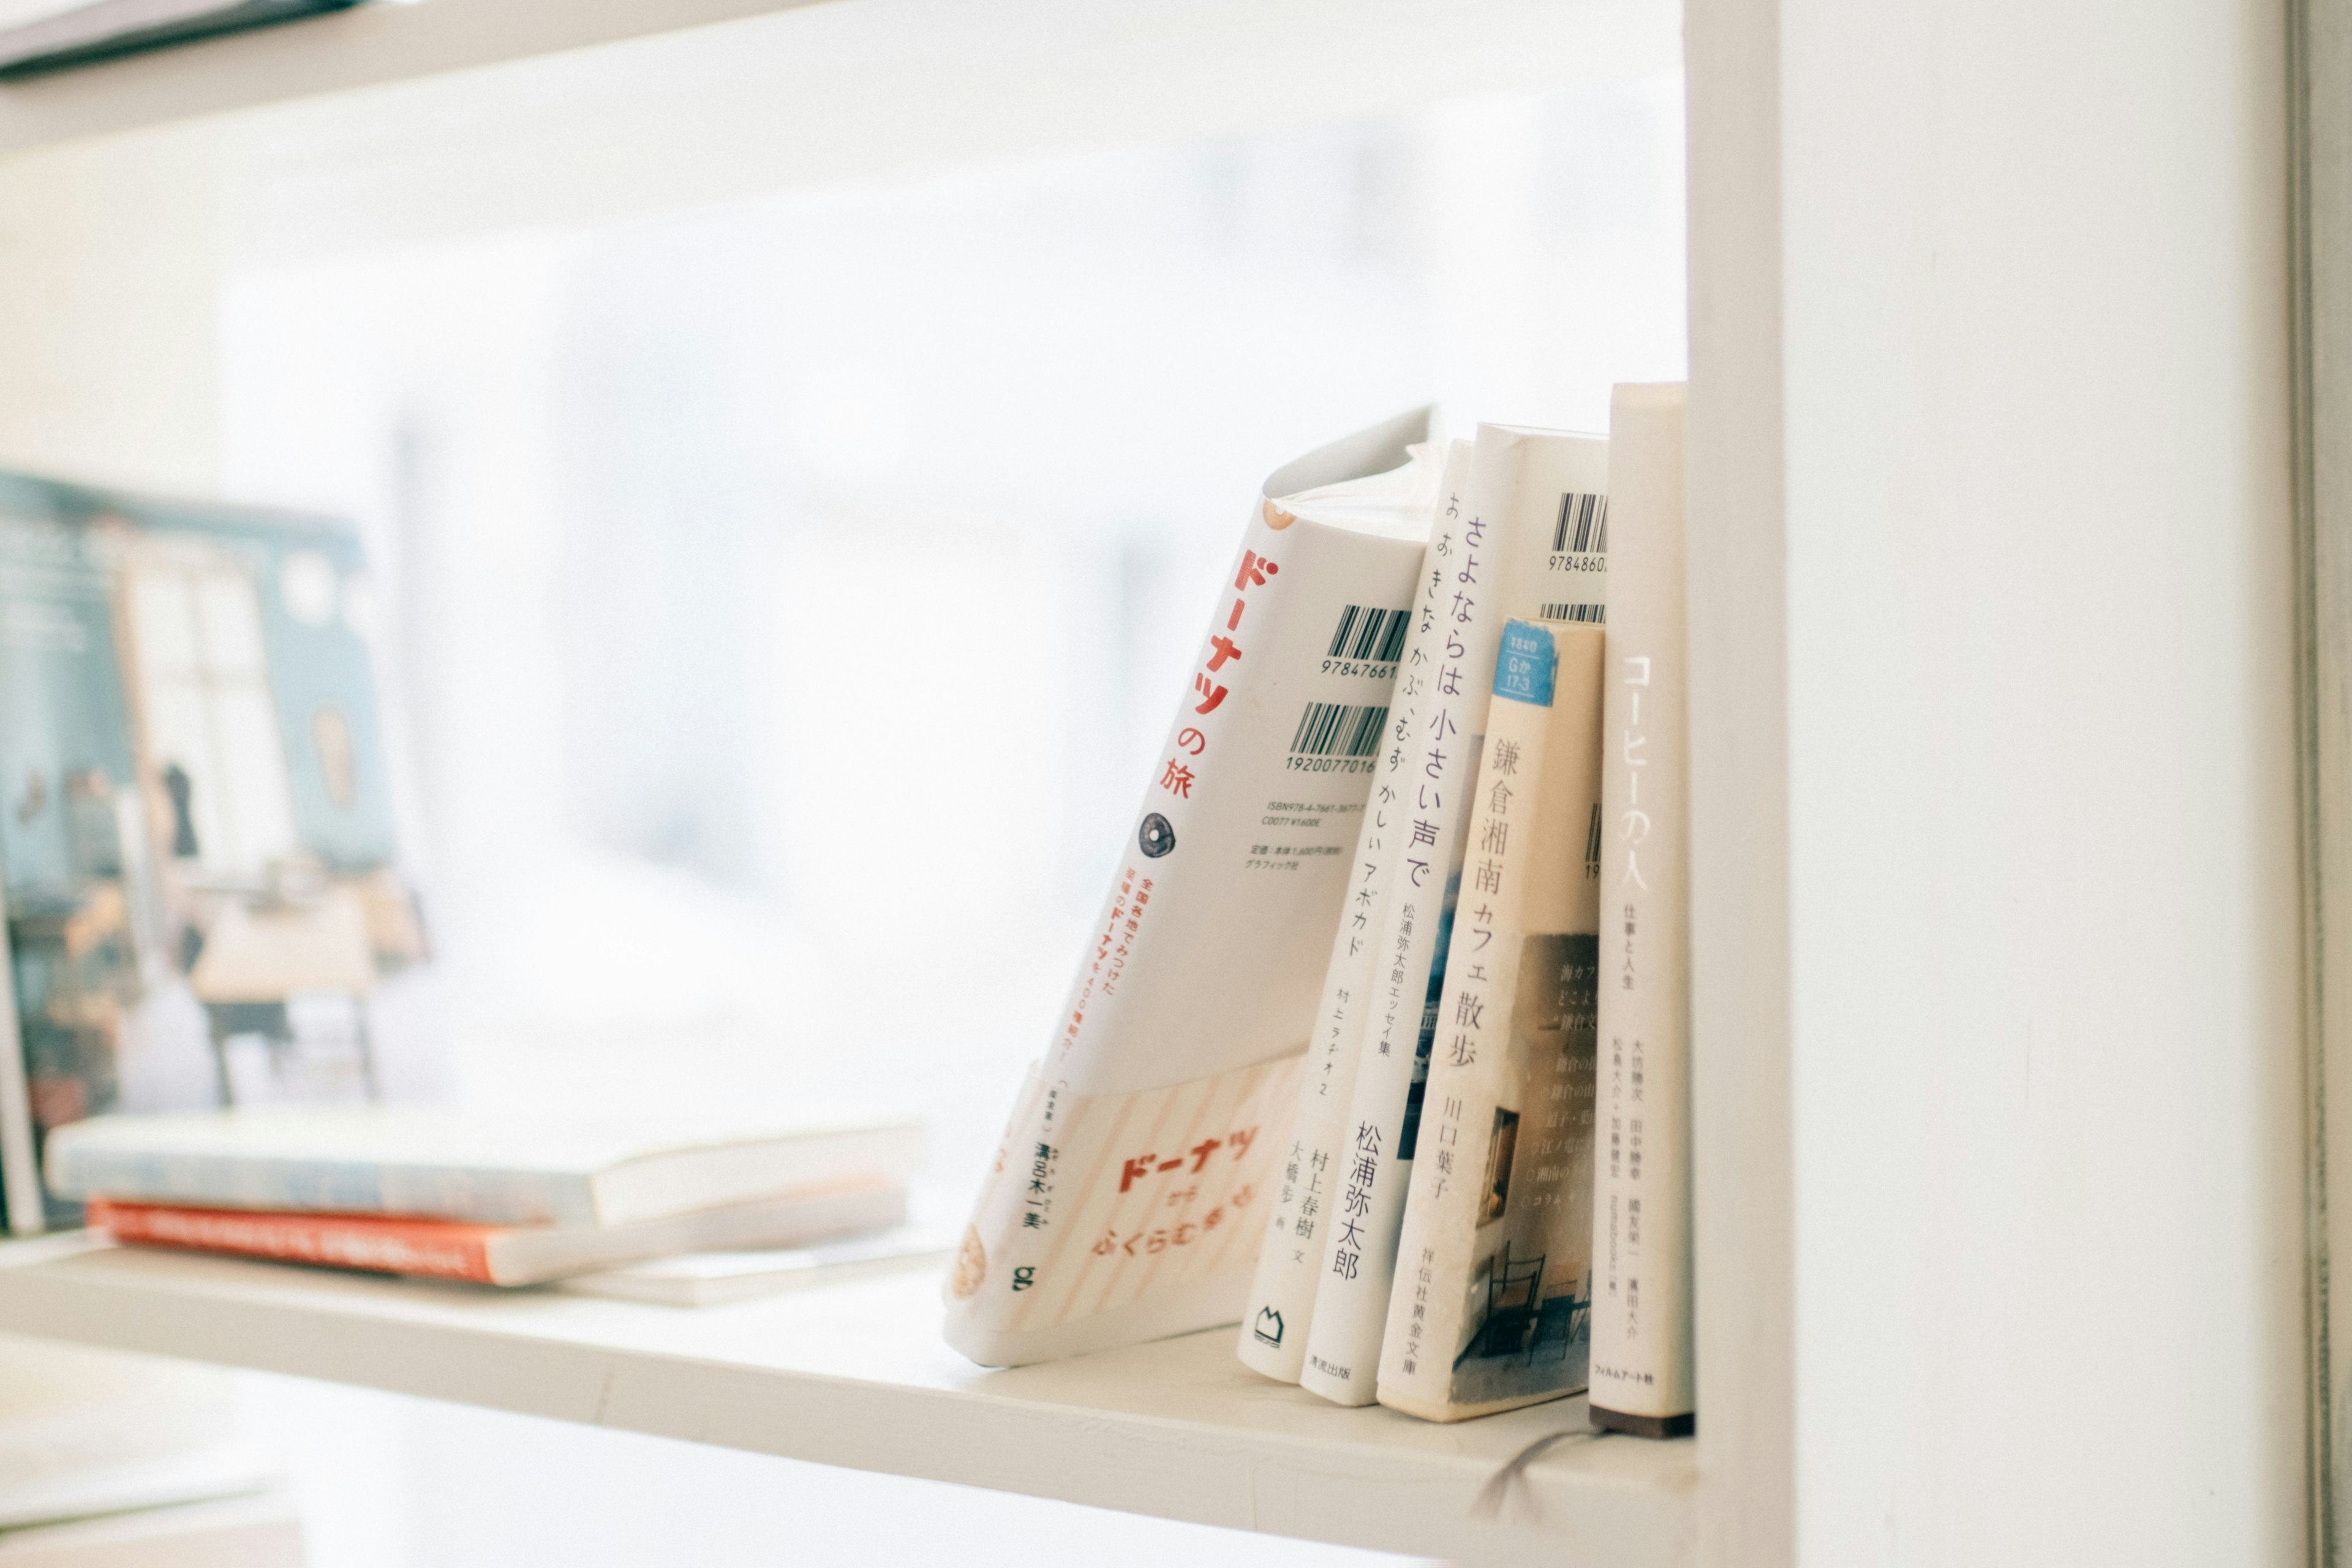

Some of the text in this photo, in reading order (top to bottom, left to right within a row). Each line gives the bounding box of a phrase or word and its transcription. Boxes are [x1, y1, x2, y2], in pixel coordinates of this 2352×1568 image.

[1548, 556, 1607, 572] 9784860
[1160, 549, 1278, 799] ドーナツの旅
[1321, 660, 1397, 680] 97847661
[1407, 516, 1487, 887] さよならは小さい声で
[1506, 675, 1531, 692] 17-3
[1509, 657, 1531, 674] Gか
[1619, 656, 1651, 891] コーヒーの人
[1448, 737, 1521, 1068] 鎌倉湘南カフェ散歩
[1586, 864, 1600, 880] 19
[1102, 878, 1153, 996] 全国各地でみつけた
[1378, 902, 1415, 1058] 松浦弥太郎エッセイ集
[1119, 1126, 1260, 1193] ドーナツ
[1281, 1140, 1304, 1204] 大橋歩
[1332, 1120, 1382, 1281] 松浦弥太郎
[1431, 1096, 1462, 1199] 川口葉子
[1292, 1148, 1330, 1264] 村上春樹 文
[1402, 1247, 1434, 1376] 祥伝社黄金文庫
